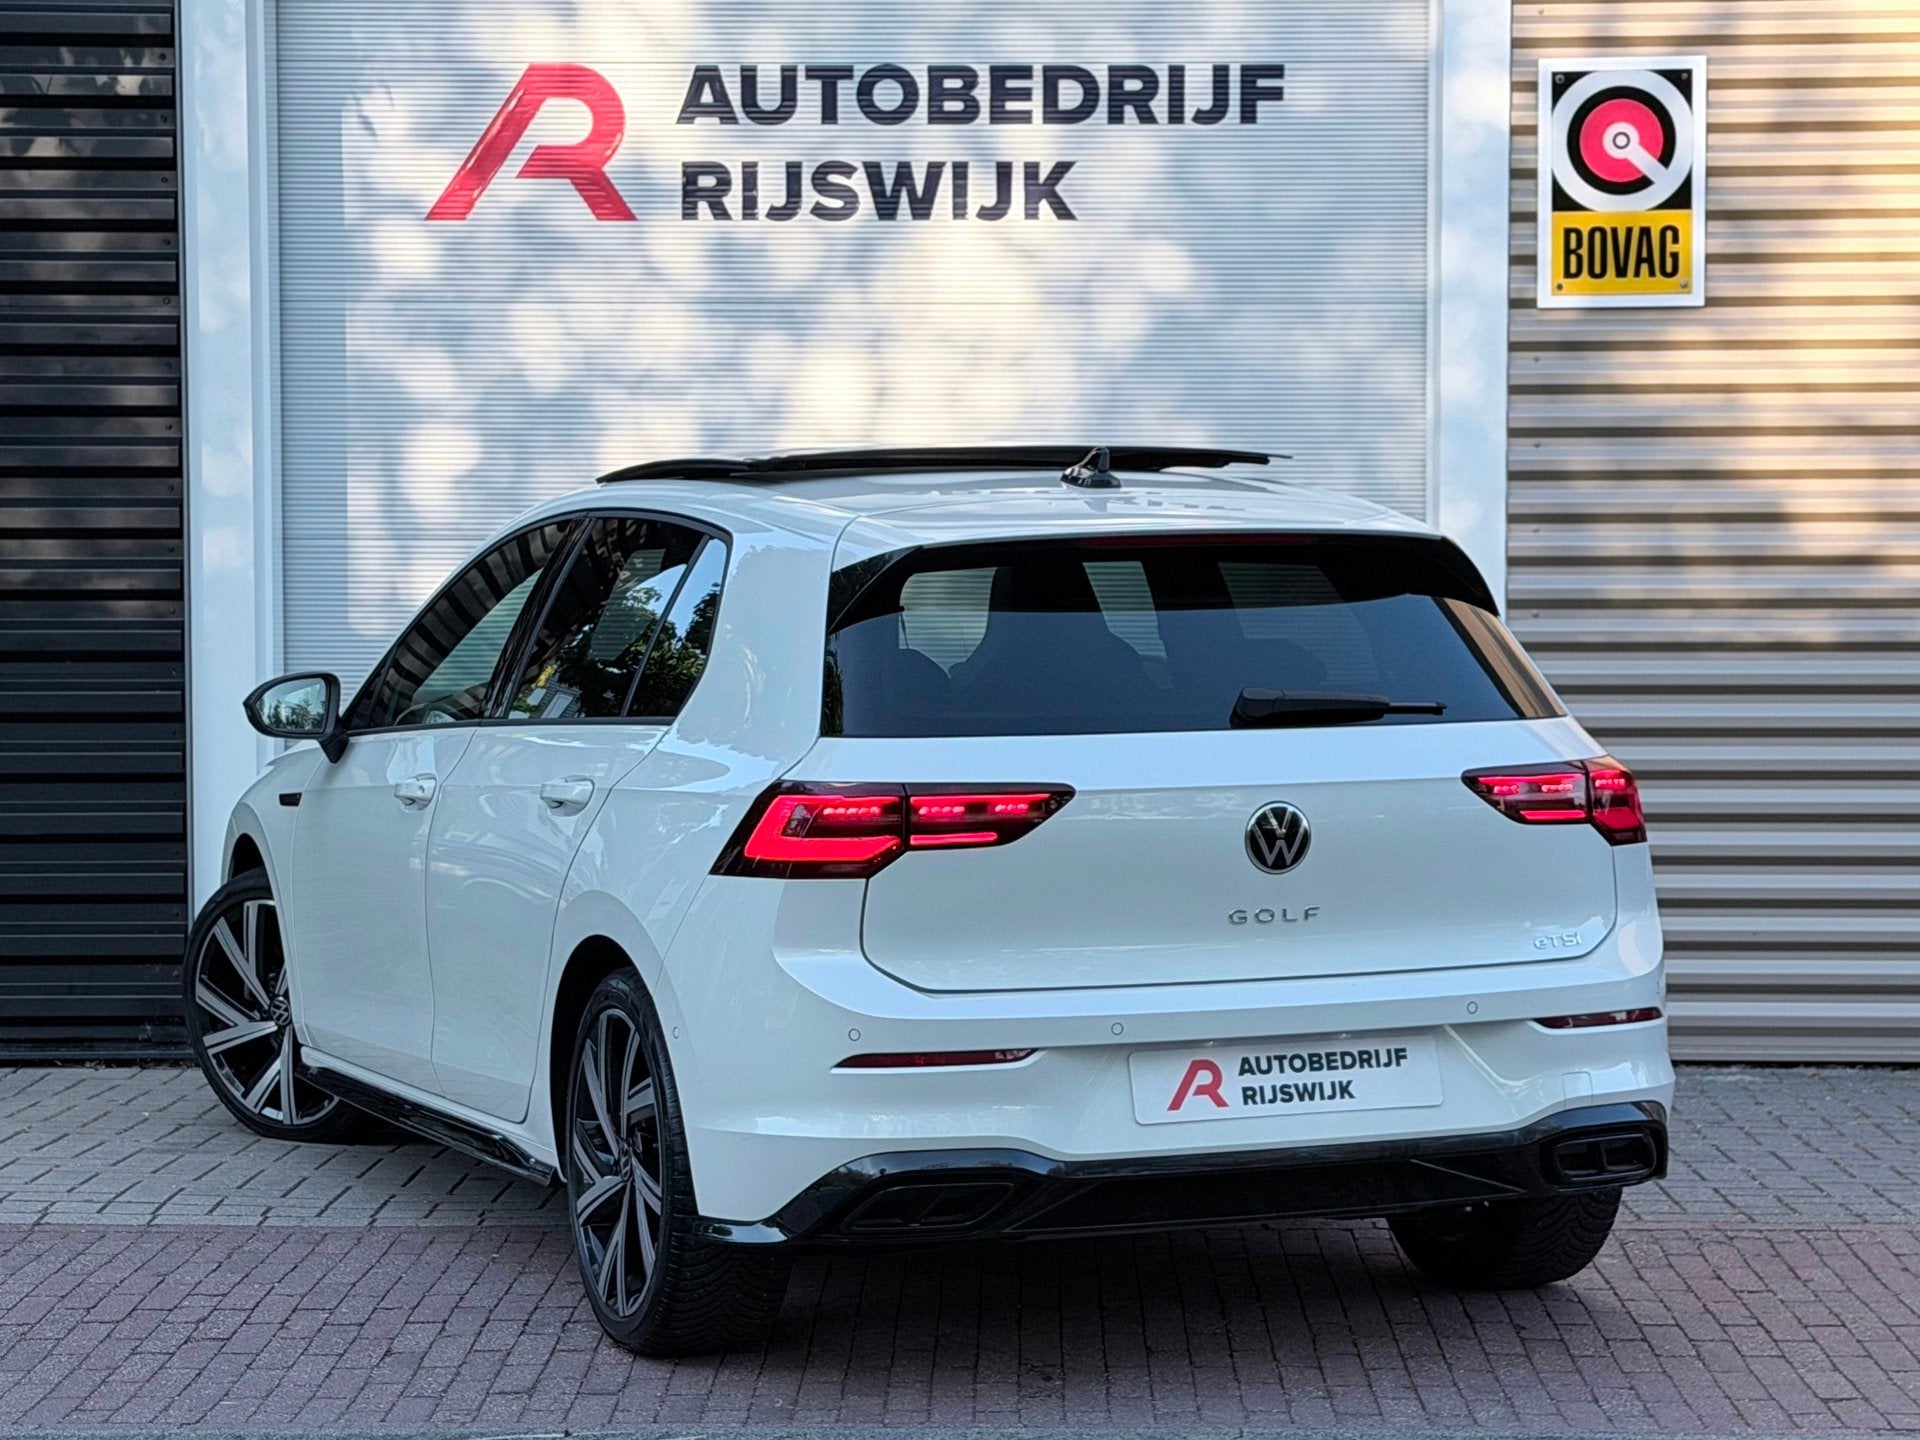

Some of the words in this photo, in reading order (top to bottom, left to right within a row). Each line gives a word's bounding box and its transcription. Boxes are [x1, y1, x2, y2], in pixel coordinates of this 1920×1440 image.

[676, 63, 1285, 125] AUTOBEDRIJF
[681, 160, 1078, 221] RIJSWIJK
[1563, 224, 1680, 279] BOVAG
[1228, 906, 1320, 925] GOLF
[1238, 1048, 1408, 1077] AUTOBEDRIJF
[1241, 1080, 1356, 1106] RIJSWIJK
